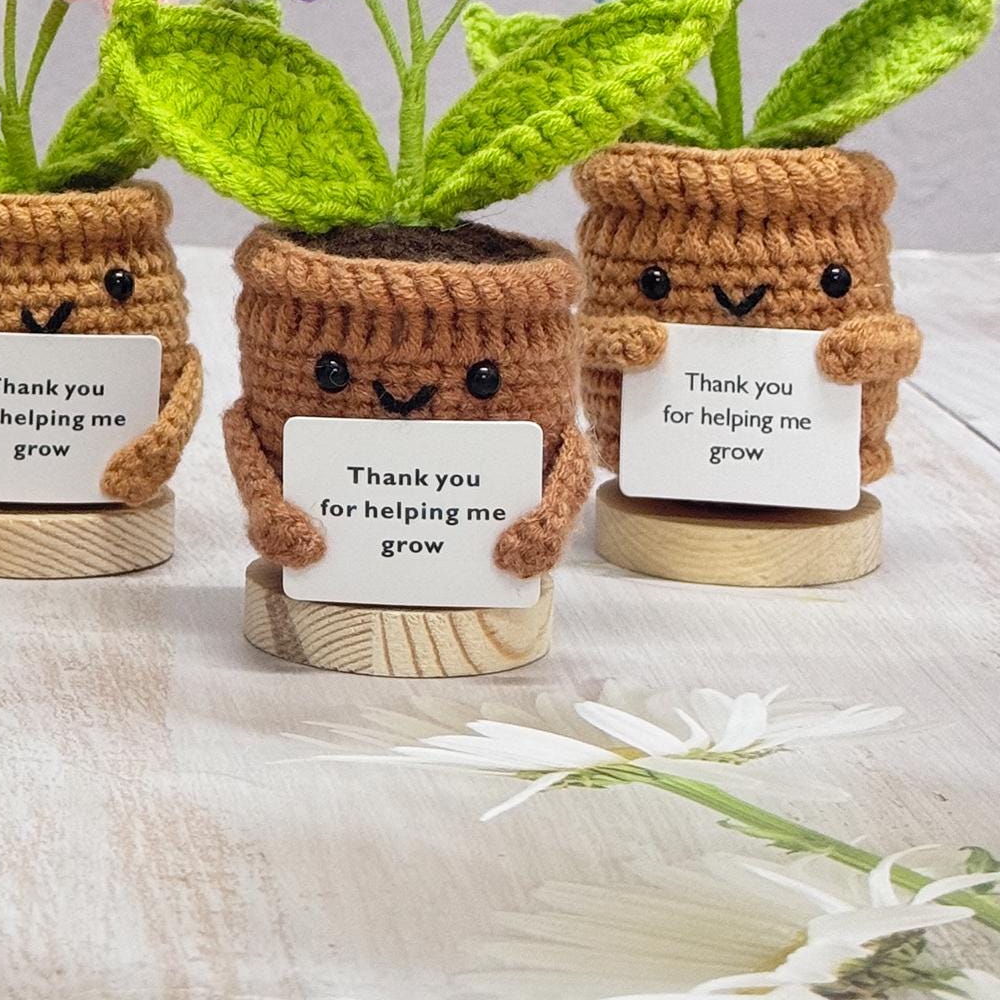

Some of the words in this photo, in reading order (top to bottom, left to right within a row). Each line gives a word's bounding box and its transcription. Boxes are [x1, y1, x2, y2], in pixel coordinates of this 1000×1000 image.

[65, 384, 105, 401] you
[684, 372, 749, 394] Thank
[754, 382, 793, 401] you
[0, 408, 86, 432] helping
[91, 414, 127, 427] me
[663, 404, 694, 425] for
[701, 406, 774, 434] helping
[780, 416, 812, 430] me
[13, 444, 71, 461] grow
[709, 446, 764, 465] grow
[346, 466, 429, 487] Thank
[434, 474, 480, 492] you
[320, 499, 358, 518] for
[364, 500, 460, 526] helping
[467, 508, 506, 521] me
[380, 540, 445, 558] grow
